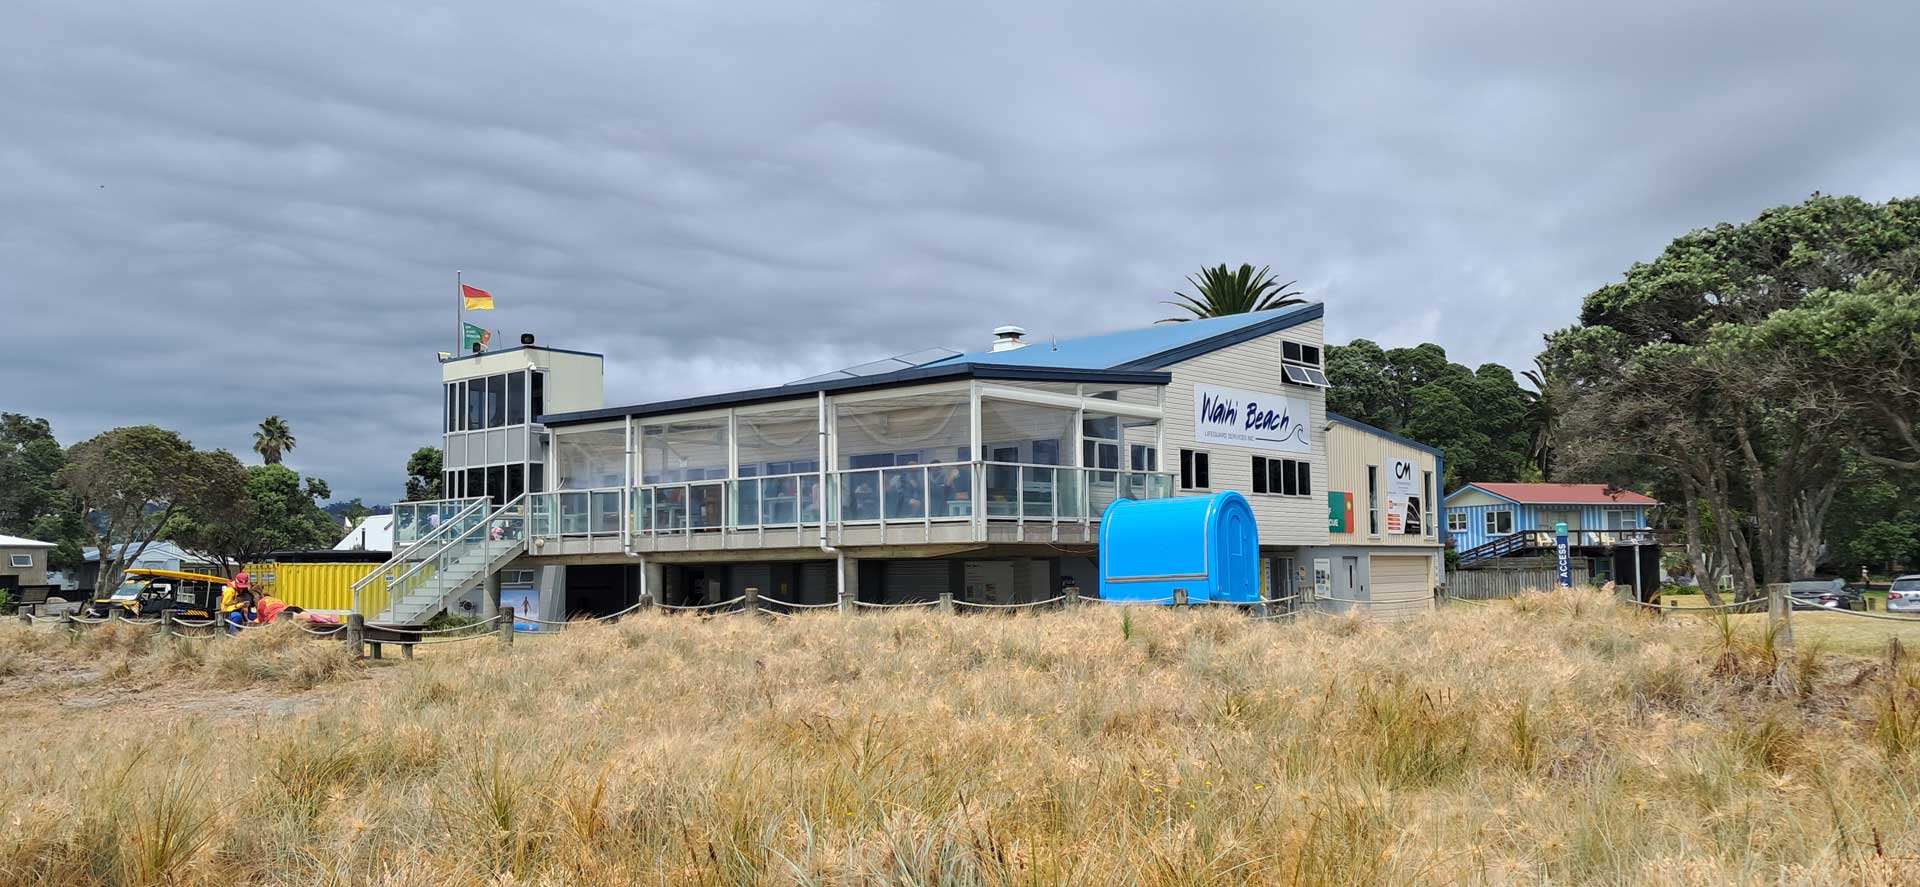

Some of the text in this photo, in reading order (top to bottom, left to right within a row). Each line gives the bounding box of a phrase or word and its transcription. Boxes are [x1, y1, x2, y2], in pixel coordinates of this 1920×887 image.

[1201, 391, 1289, 432] Waihi Beach
[1395, 461, 1411, 481] CM
[1558, 543, 1568, 577] ACCESS
